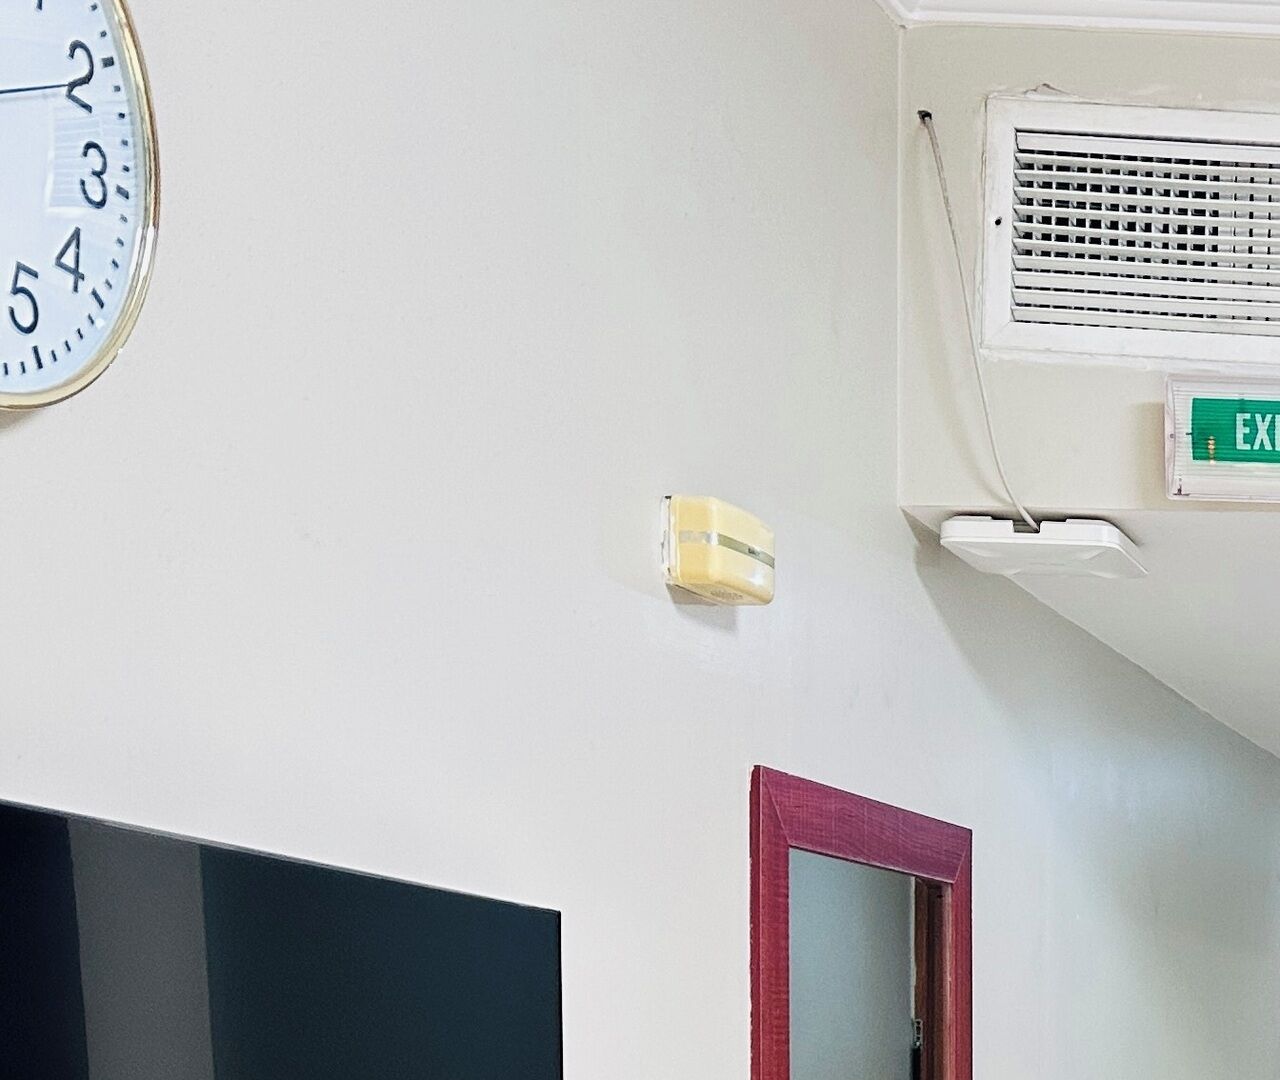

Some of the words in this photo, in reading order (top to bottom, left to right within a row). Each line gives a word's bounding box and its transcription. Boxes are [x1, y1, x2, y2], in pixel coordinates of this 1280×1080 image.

[65, 39, 94, 114] 2
[79, 140, 108, 210] 3
[54, 226, 85, 293] 4
[8, 260, 39, 335] 5
